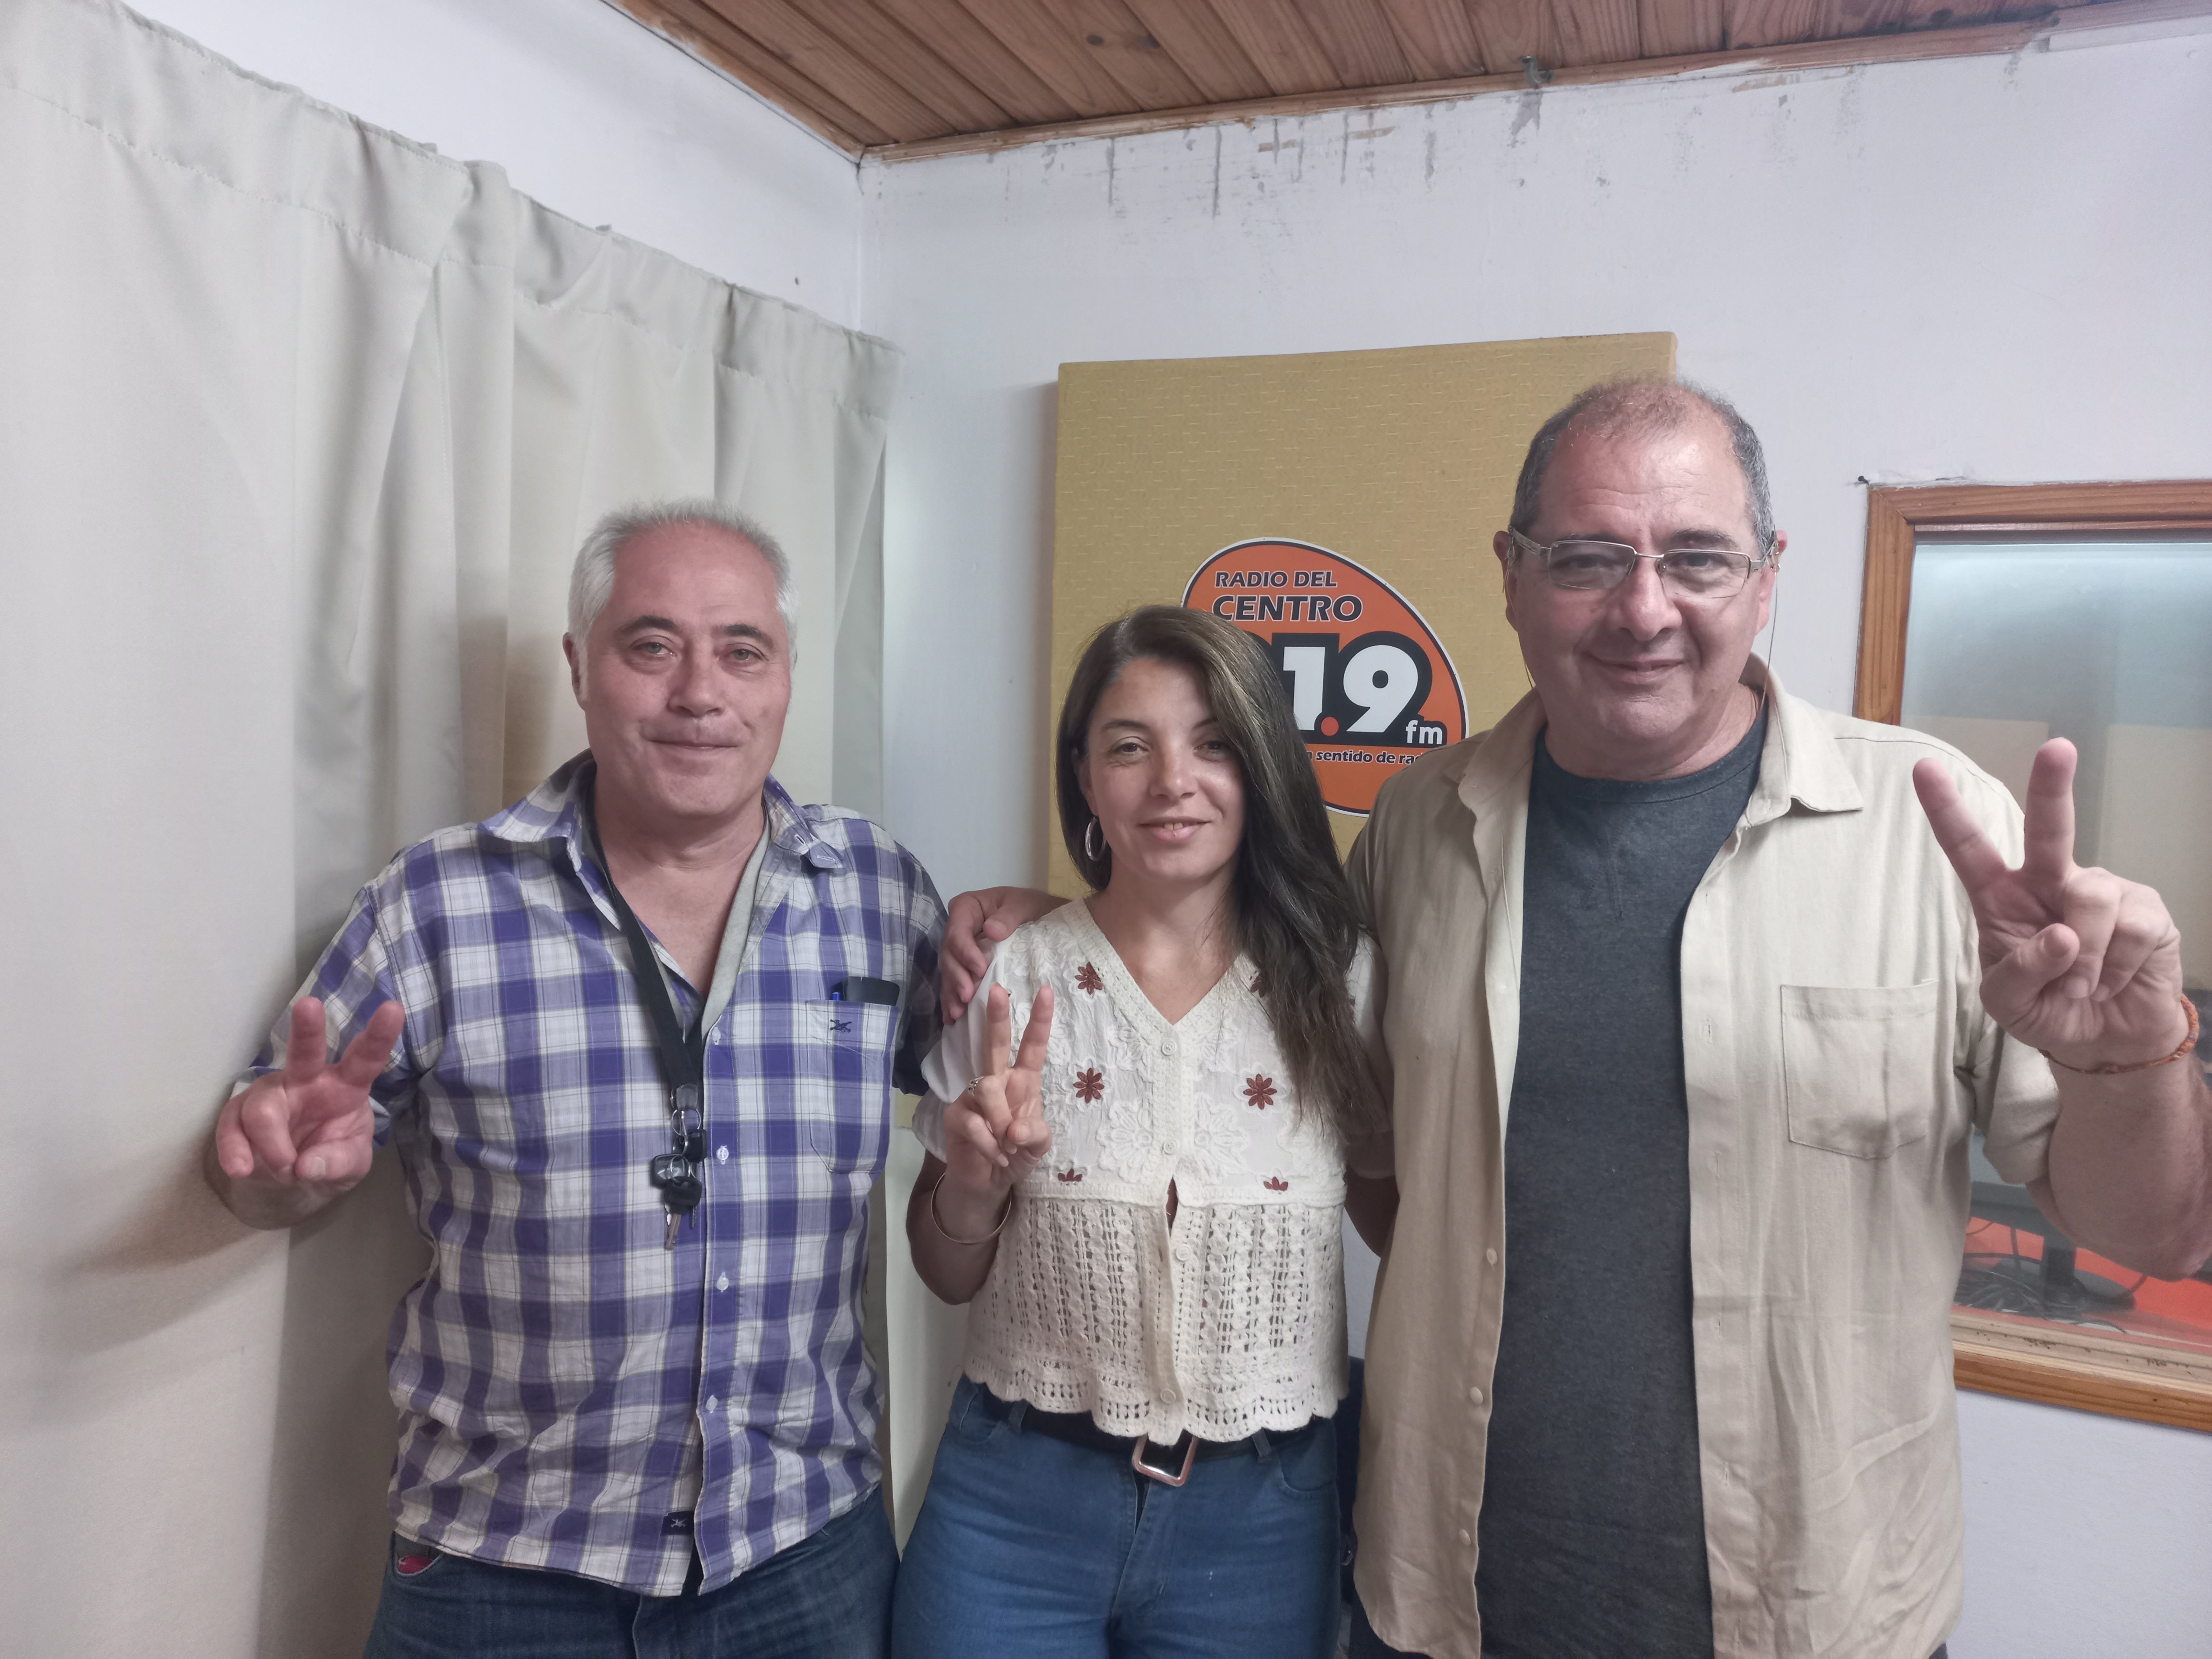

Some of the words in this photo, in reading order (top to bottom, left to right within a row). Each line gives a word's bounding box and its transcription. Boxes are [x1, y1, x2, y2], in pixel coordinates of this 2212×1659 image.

[1215, 571, 1288, 588] RADIO
[1293, 571, 1338, 587] DEL
[1212, 595, 1363, 622] CENTRO
[1282, 645, 1418, 733] 1.9
[1405, 719, 1443, 745] fm
[1316, 750, 1373, 763] sentido
[1376, 751, 1396, 764] de
[1398, 752, 1423, 764] ra
